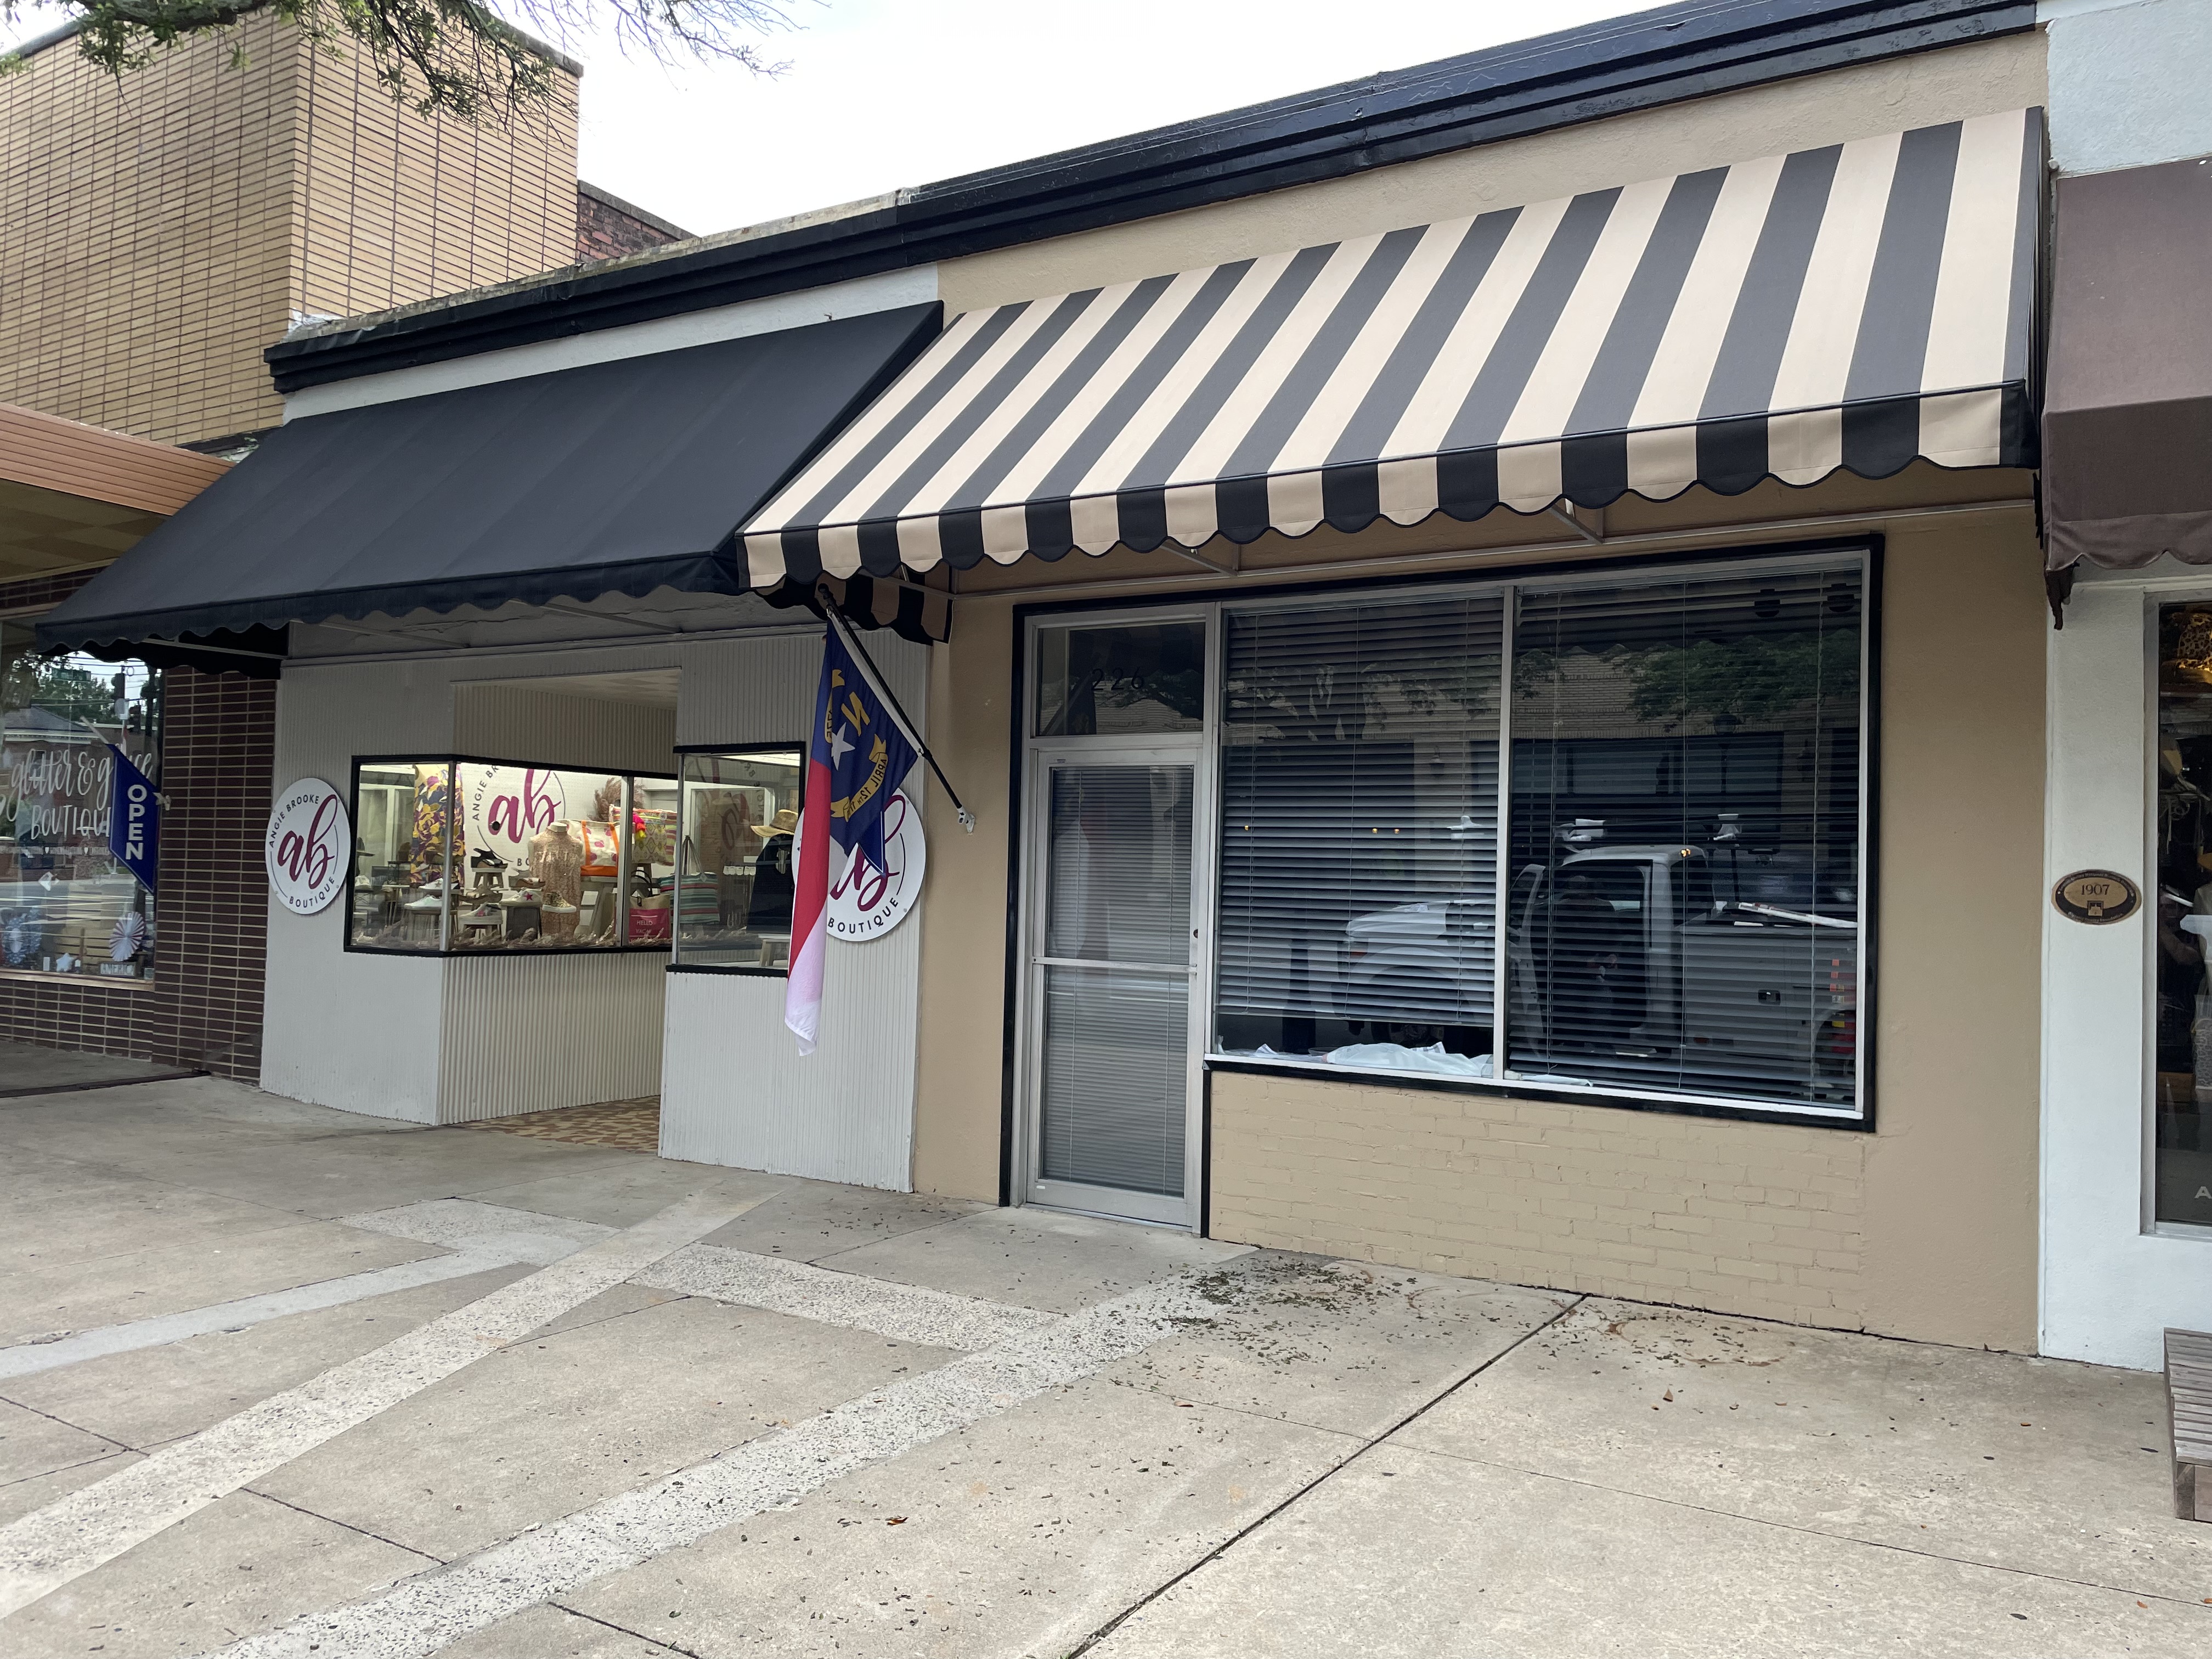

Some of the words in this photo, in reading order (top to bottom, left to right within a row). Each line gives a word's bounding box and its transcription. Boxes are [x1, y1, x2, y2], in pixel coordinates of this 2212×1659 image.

[1092, 668, 1144, 691] 226
[472, 781, 487, 821] ANGIE
[125, 785, 148, 860] OPEN
[269, 811, 285, 848] ANGIE
[286, 794, 319, 812] BROOKE
[277, 794, 337, 890] ab
[289, 876, 335, 908] BOUTIQUE
[2081, 884, 2110, 895] 1907
[827, 898, 899, 934] BOUTIQUE
